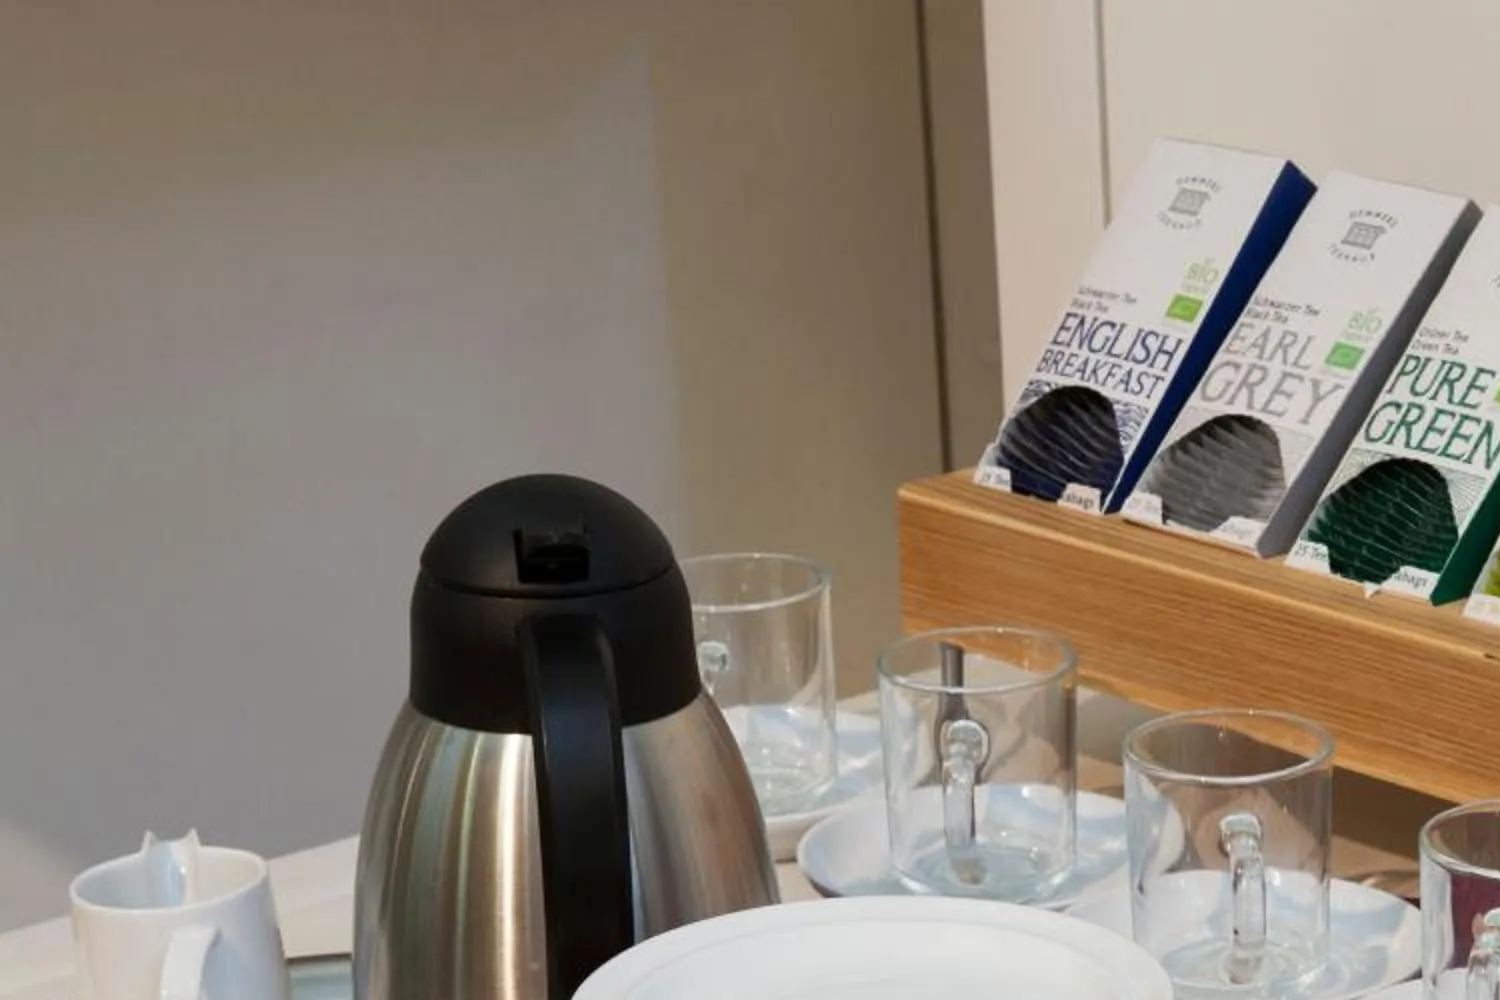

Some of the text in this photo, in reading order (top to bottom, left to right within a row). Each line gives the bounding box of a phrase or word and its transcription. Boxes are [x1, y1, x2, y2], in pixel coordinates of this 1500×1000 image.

[1050, 312, 1184, 373] ENGLISH
[1226, 322, 1317, 371] EARL
[1035, 348, 1165, 399] BREAKFAST
[1199, 360, 1345, 425] GREY
[1386, 353, 1497, 410] PURE
